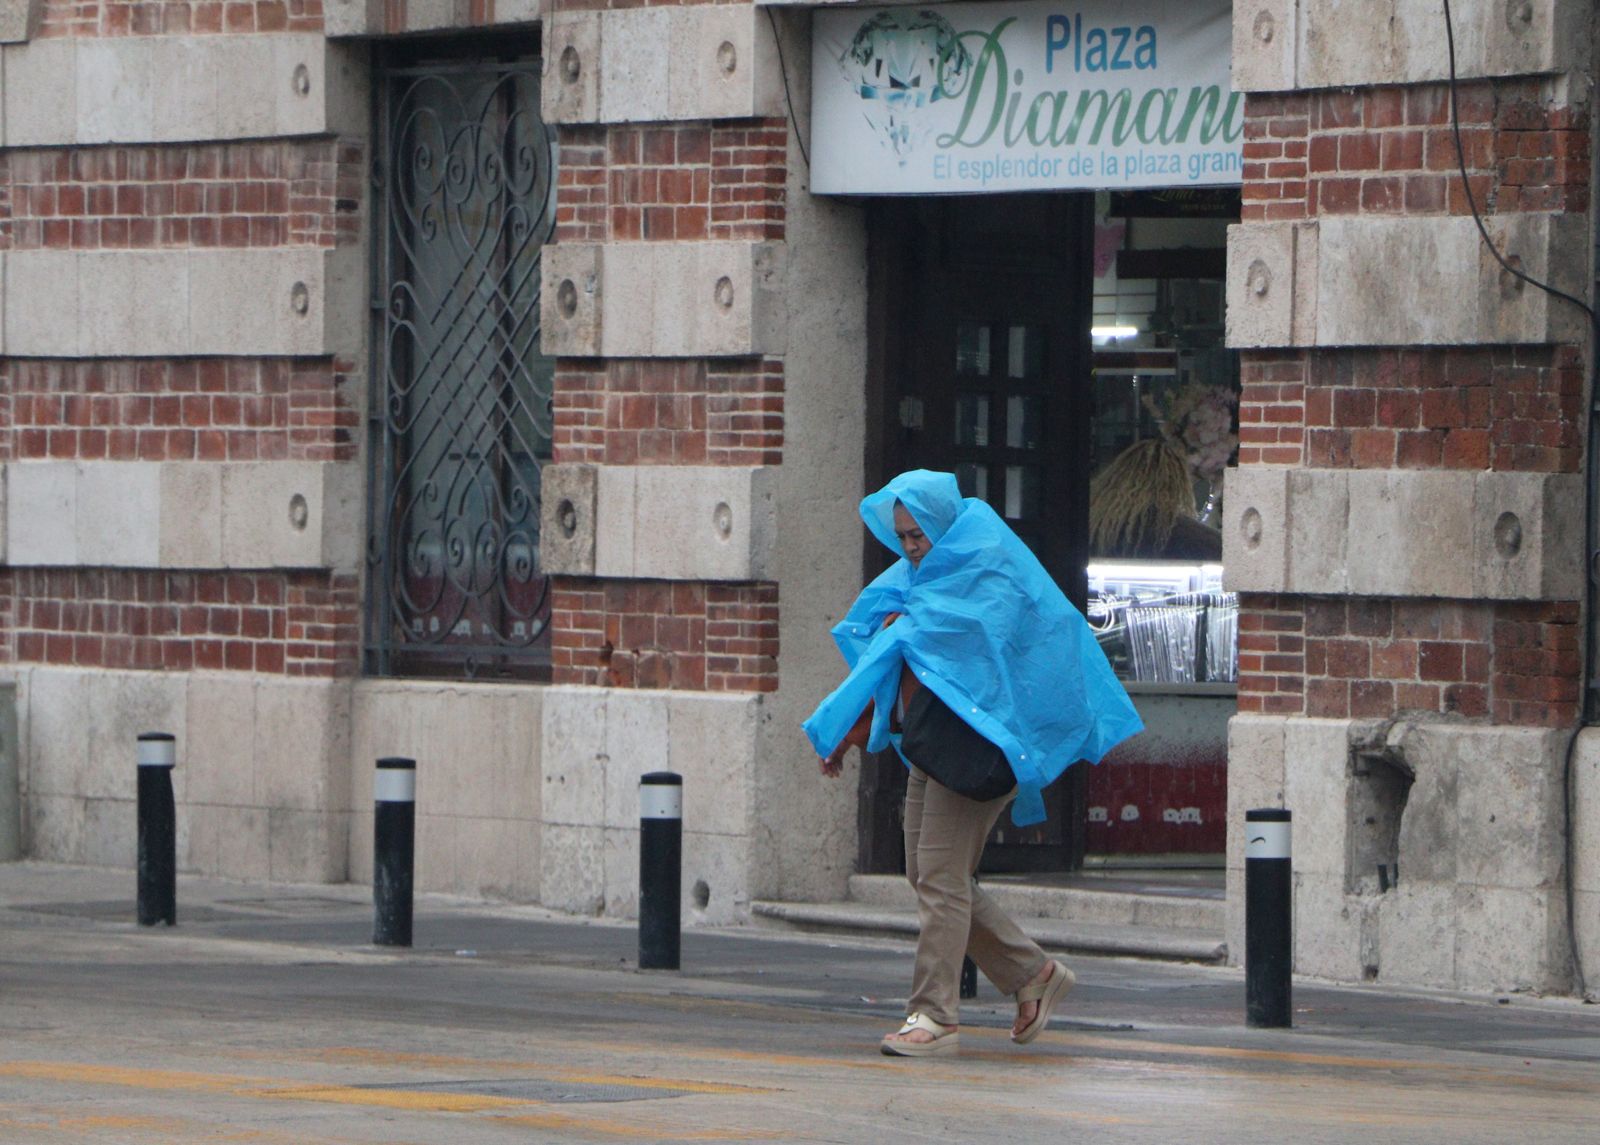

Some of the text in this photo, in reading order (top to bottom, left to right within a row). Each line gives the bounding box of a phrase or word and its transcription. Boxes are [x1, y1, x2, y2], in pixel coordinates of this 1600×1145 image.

[1045, 12, 1157, 74] Plaza
[933, 154, 950, 180] El
[958, 152, 1062, 186] esplendor
[1068, 151, 1094, 176] de
[1100, 150, 1118, 176] la
[1125, 149, 1181, 181] plaza
